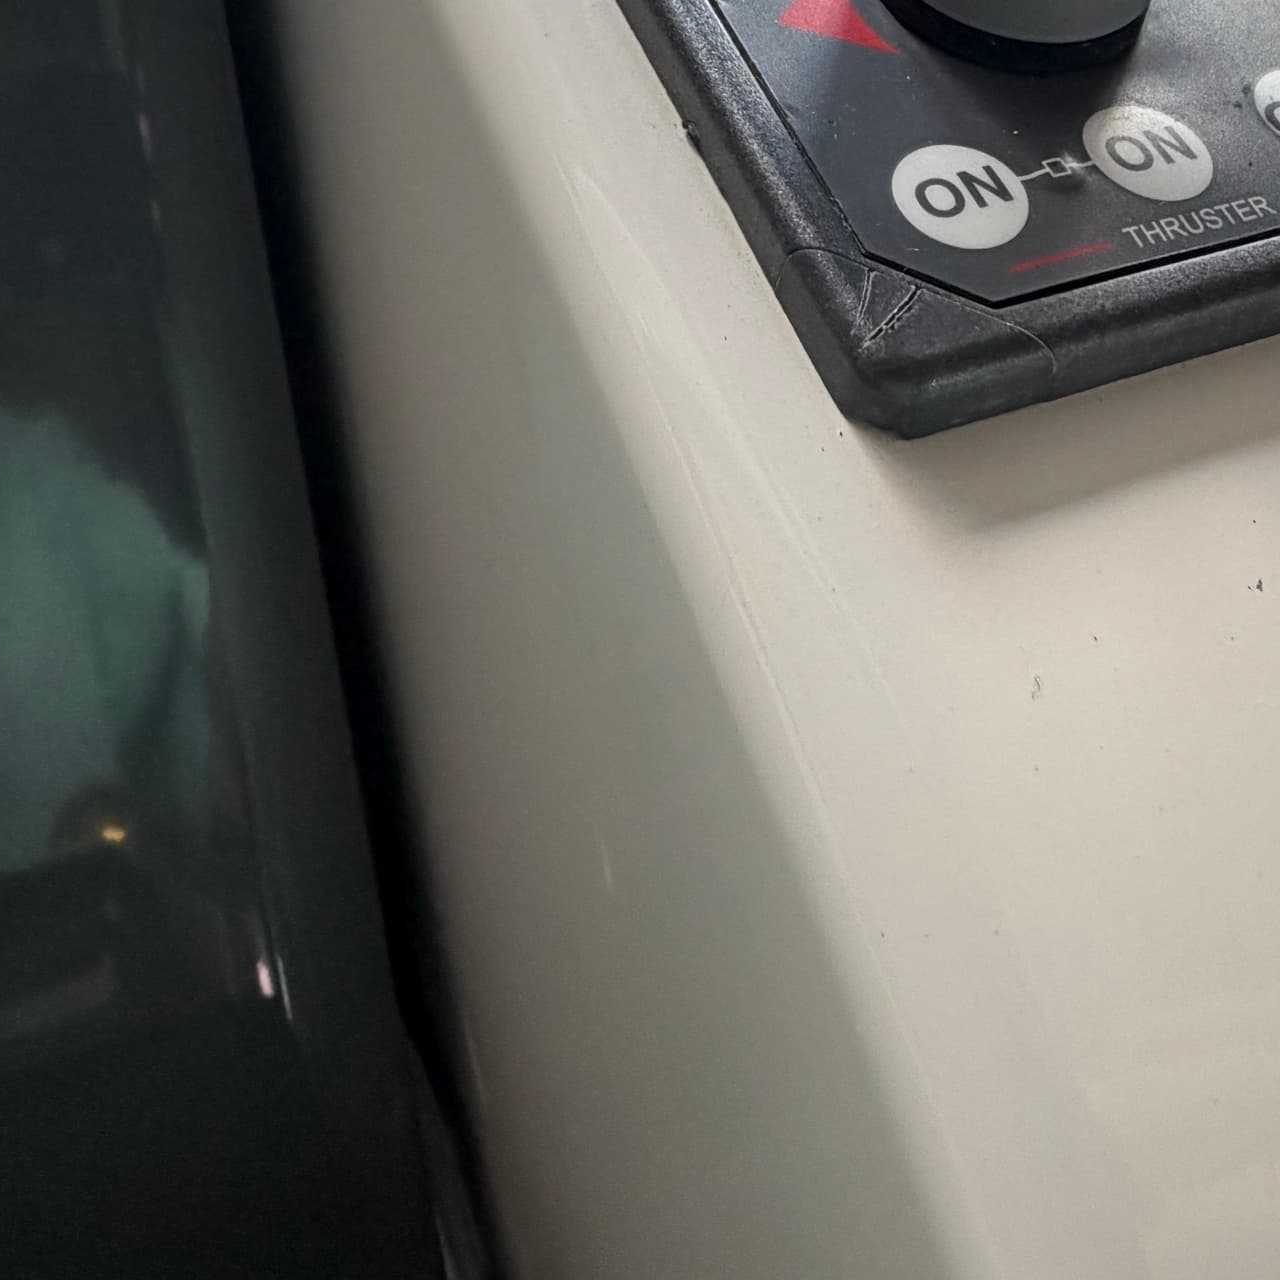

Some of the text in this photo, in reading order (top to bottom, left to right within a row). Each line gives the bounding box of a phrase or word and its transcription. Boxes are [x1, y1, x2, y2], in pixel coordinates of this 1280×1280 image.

[1104, 125, 1199, 172] ON
[914, 164, 1014, 219] ON
[1121, 194, 1277, 250] THRUSTER
